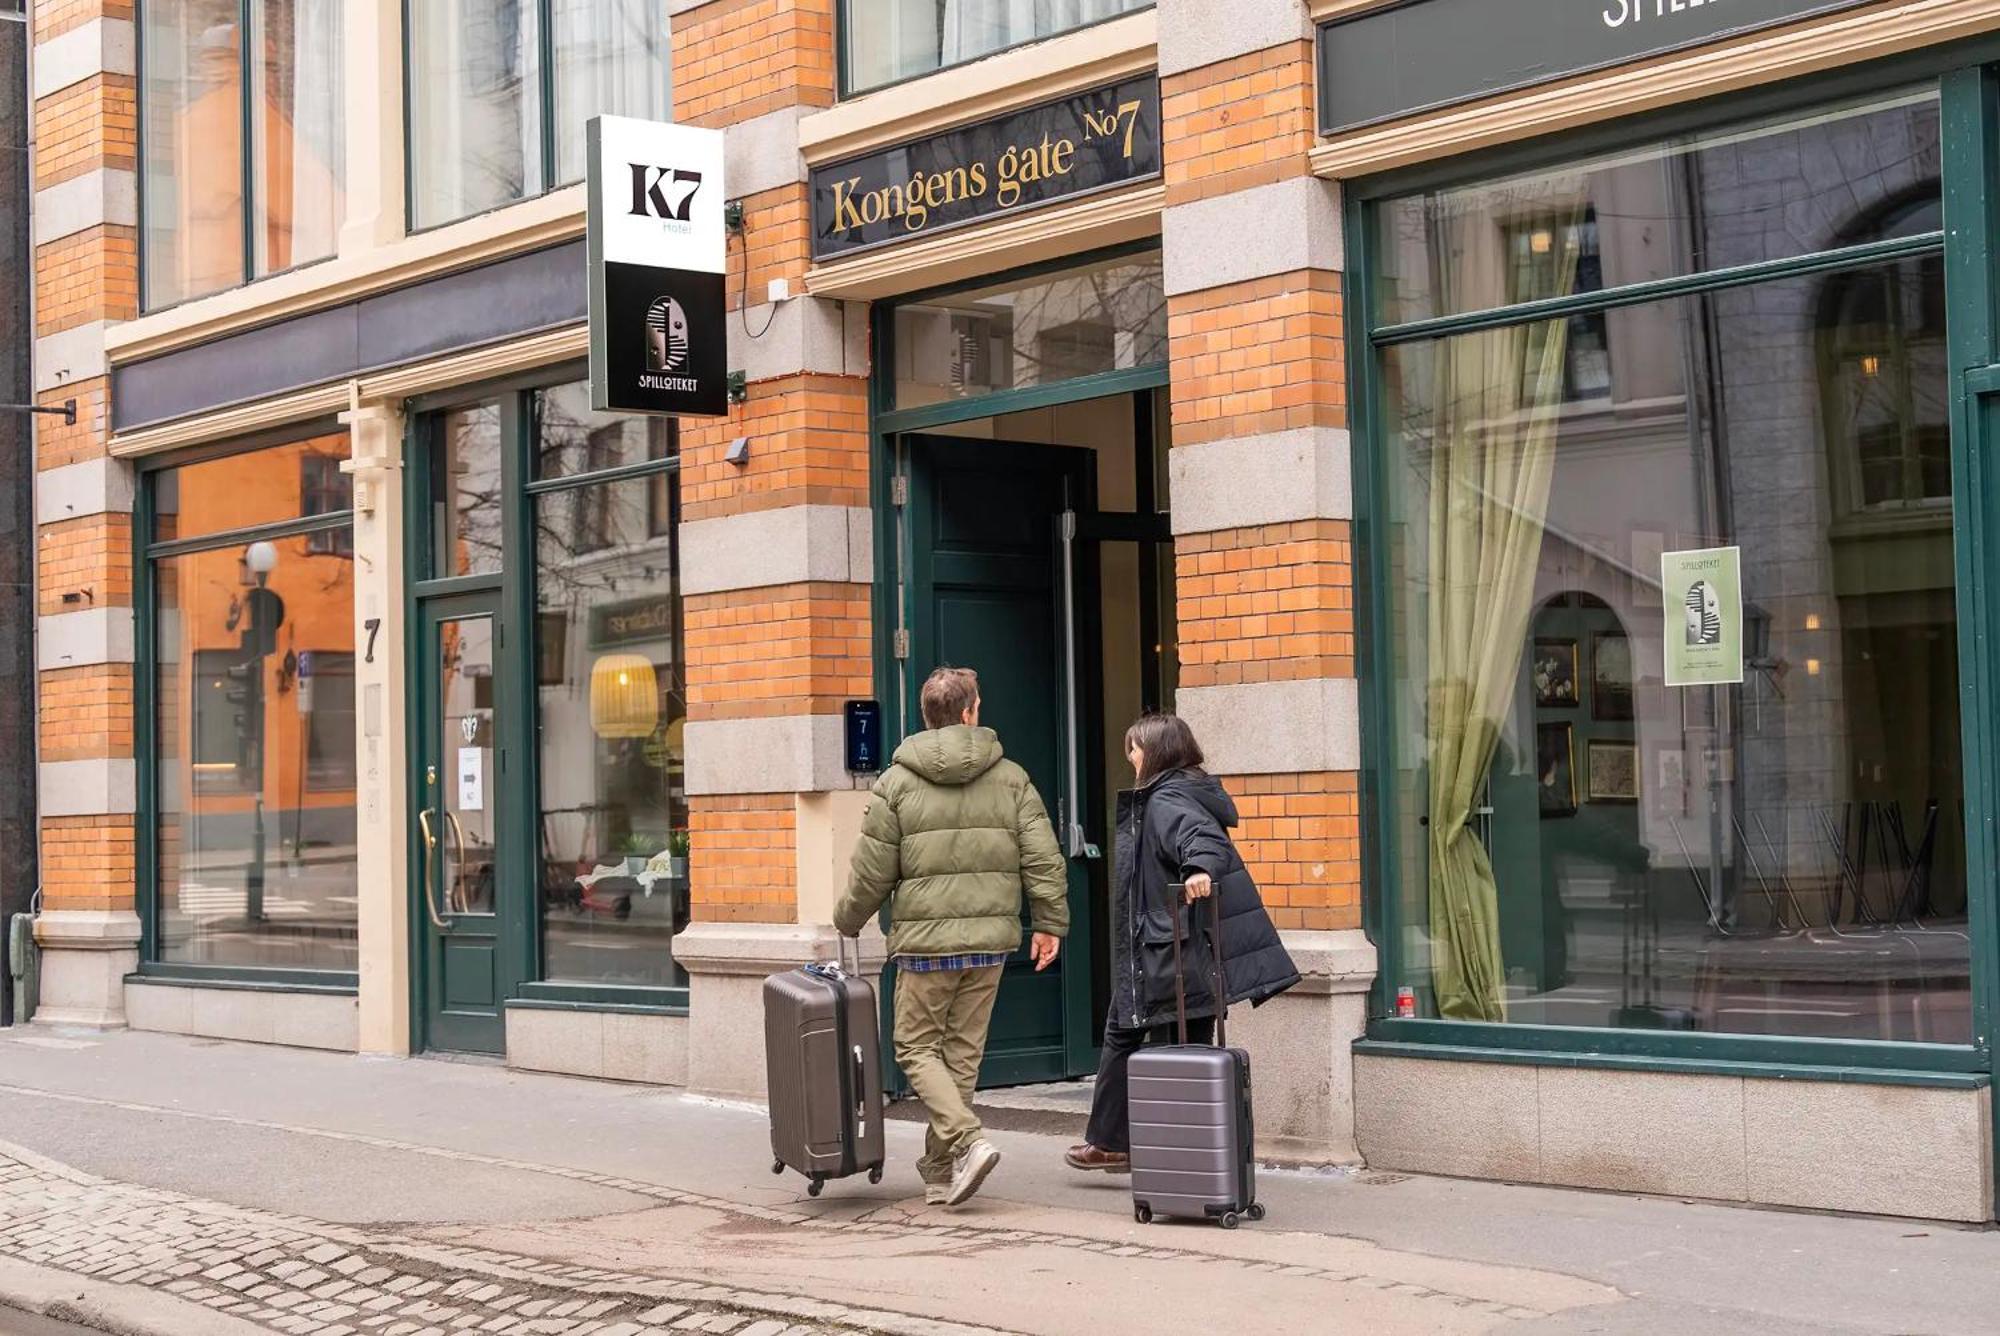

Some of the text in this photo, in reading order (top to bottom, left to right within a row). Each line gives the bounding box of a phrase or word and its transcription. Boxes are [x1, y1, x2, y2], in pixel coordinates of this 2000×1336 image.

[627, 163, 702, 221] K7
[831, 161, 987, 233] Kongens
[996, 131, 1075, 207] gate
[662, 223, 692, 235] Hotel
[638, 374, 698, 392] SPILLOTEKET
[364, 618, 381, 663] 7
[859, 719, 868, 735] 7
